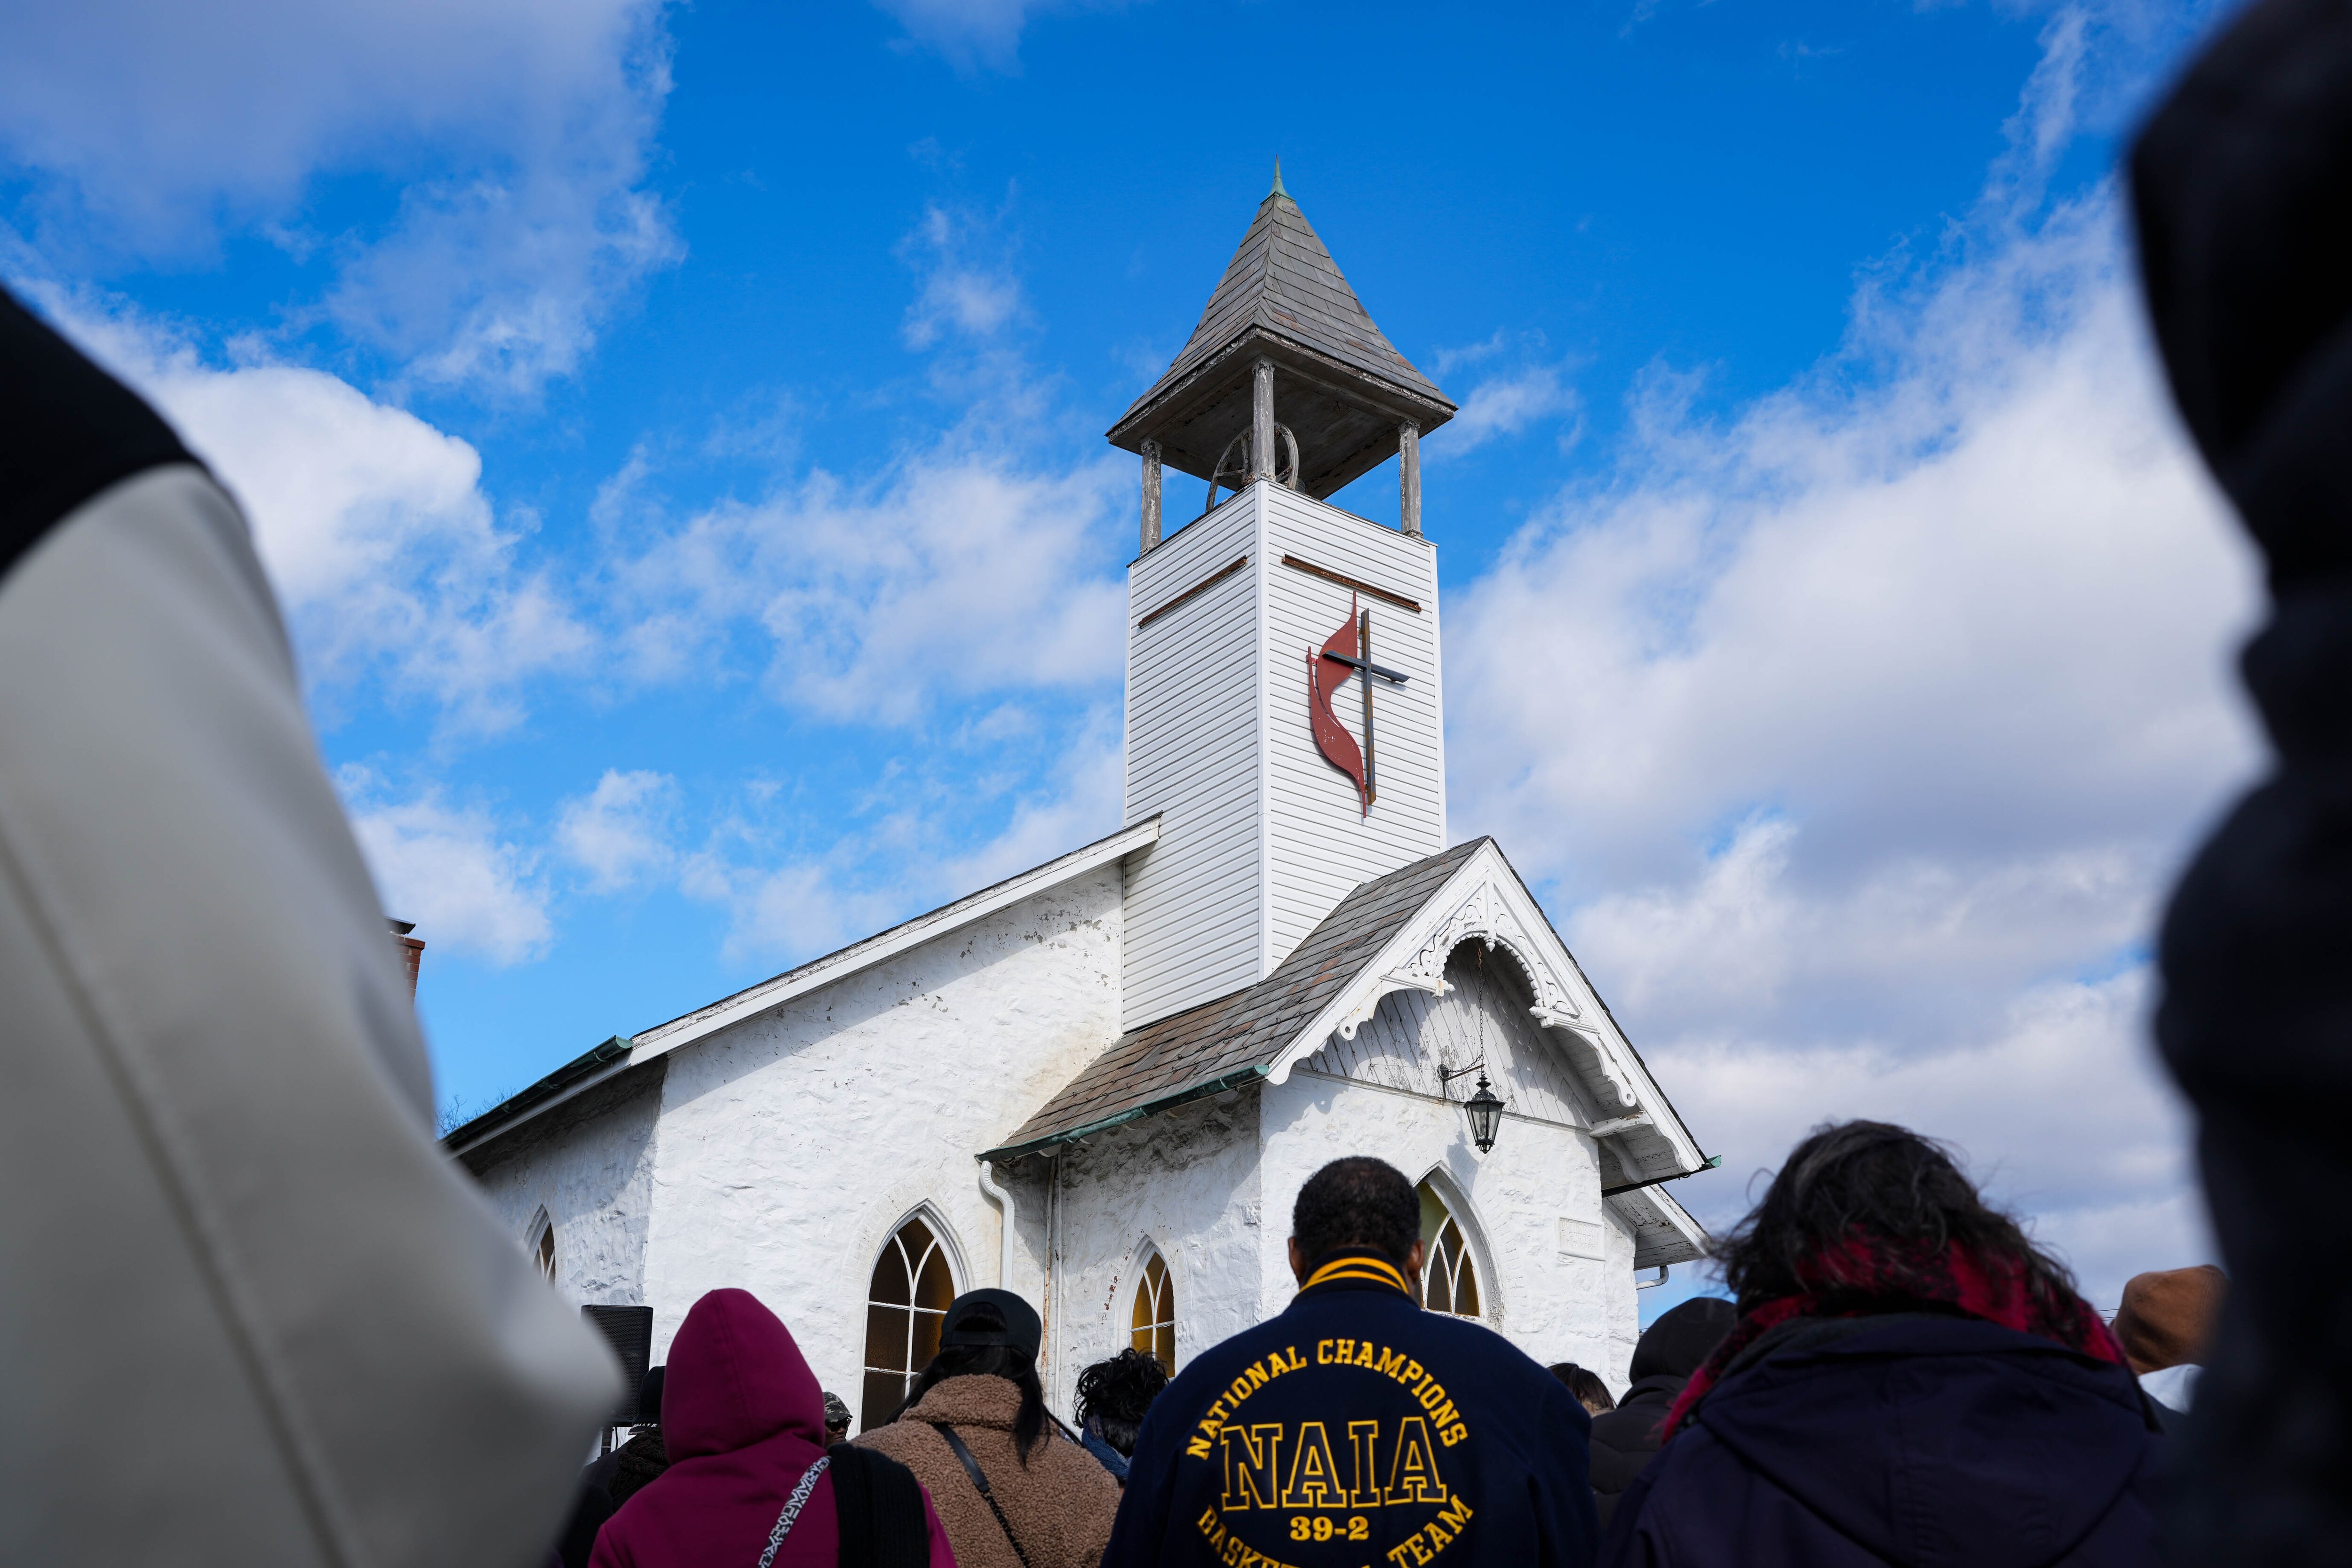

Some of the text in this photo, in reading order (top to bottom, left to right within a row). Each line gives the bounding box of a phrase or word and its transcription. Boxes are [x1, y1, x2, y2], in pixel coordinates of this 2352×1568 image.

[1186, 1338, 1468, 1460] NATIONAL CHAMPIONS
[1220, 1416, 1447, 1512] NAIA
[1290, 1516, 1369, 1542] 39-2
[1387, 1494, 1473, 1568] TEAM
